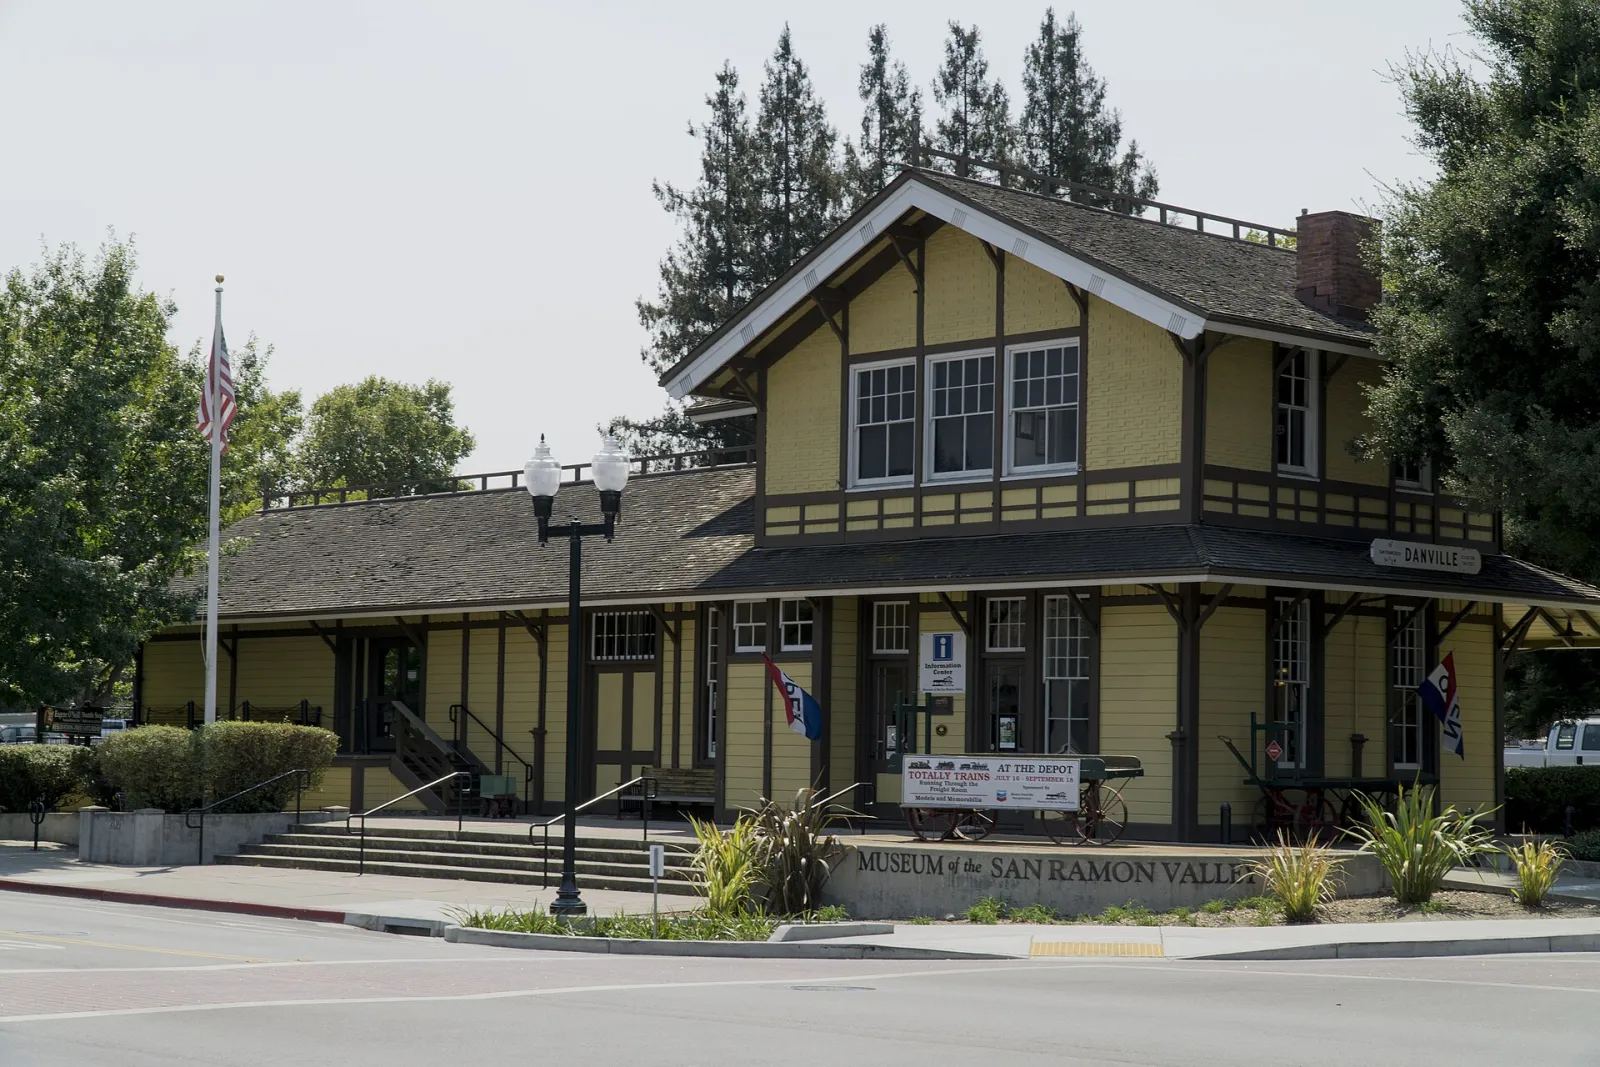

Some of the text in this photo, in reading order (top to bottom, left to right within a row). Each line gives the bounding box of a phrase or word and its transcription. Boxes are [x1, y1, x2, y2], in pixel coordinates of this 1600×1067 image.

[1405, 547, 1458, 567] DANVILLE
[908, 771, 991, 781] TOTALLY TRAINS
[997, 764, 1074, 774] AT THE DEPOT
[858, 850, 944, 875] MUSEUM
[948, 856, 960, 874] of
[964, 858, 982, 873] the
[991, 857, 1042, 880] SAN
[1048, 859, 1155, 883] RAMON
